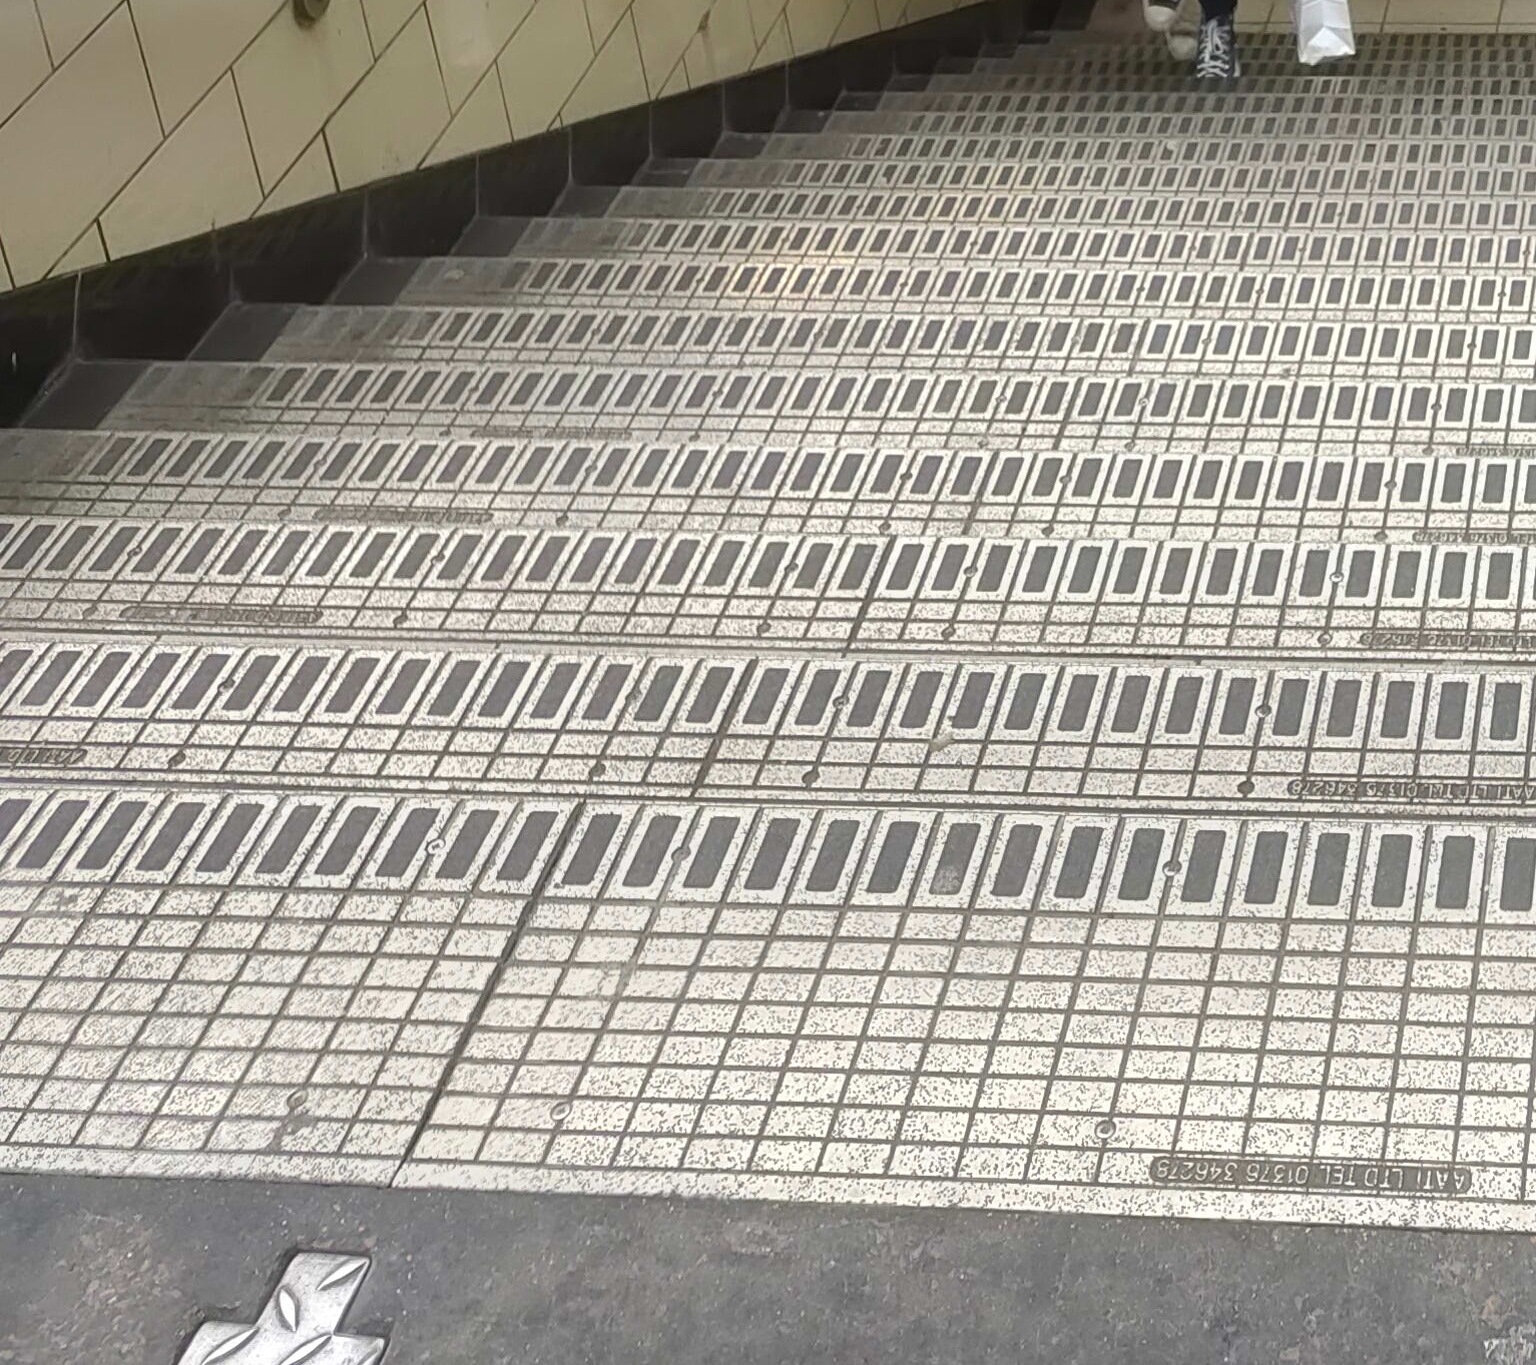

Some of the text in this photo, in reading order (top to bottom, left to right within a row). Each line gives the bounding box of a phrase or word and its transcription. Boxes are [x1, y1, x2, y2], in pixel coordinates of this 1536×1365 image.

[1156, 1158, 1239, 1182] 346278
[1246, 1160, 1310, 1185] 01376
[1320, 1164, 1356, 1187] TEL
[1364, 1167, 1404, 1188] LTD
